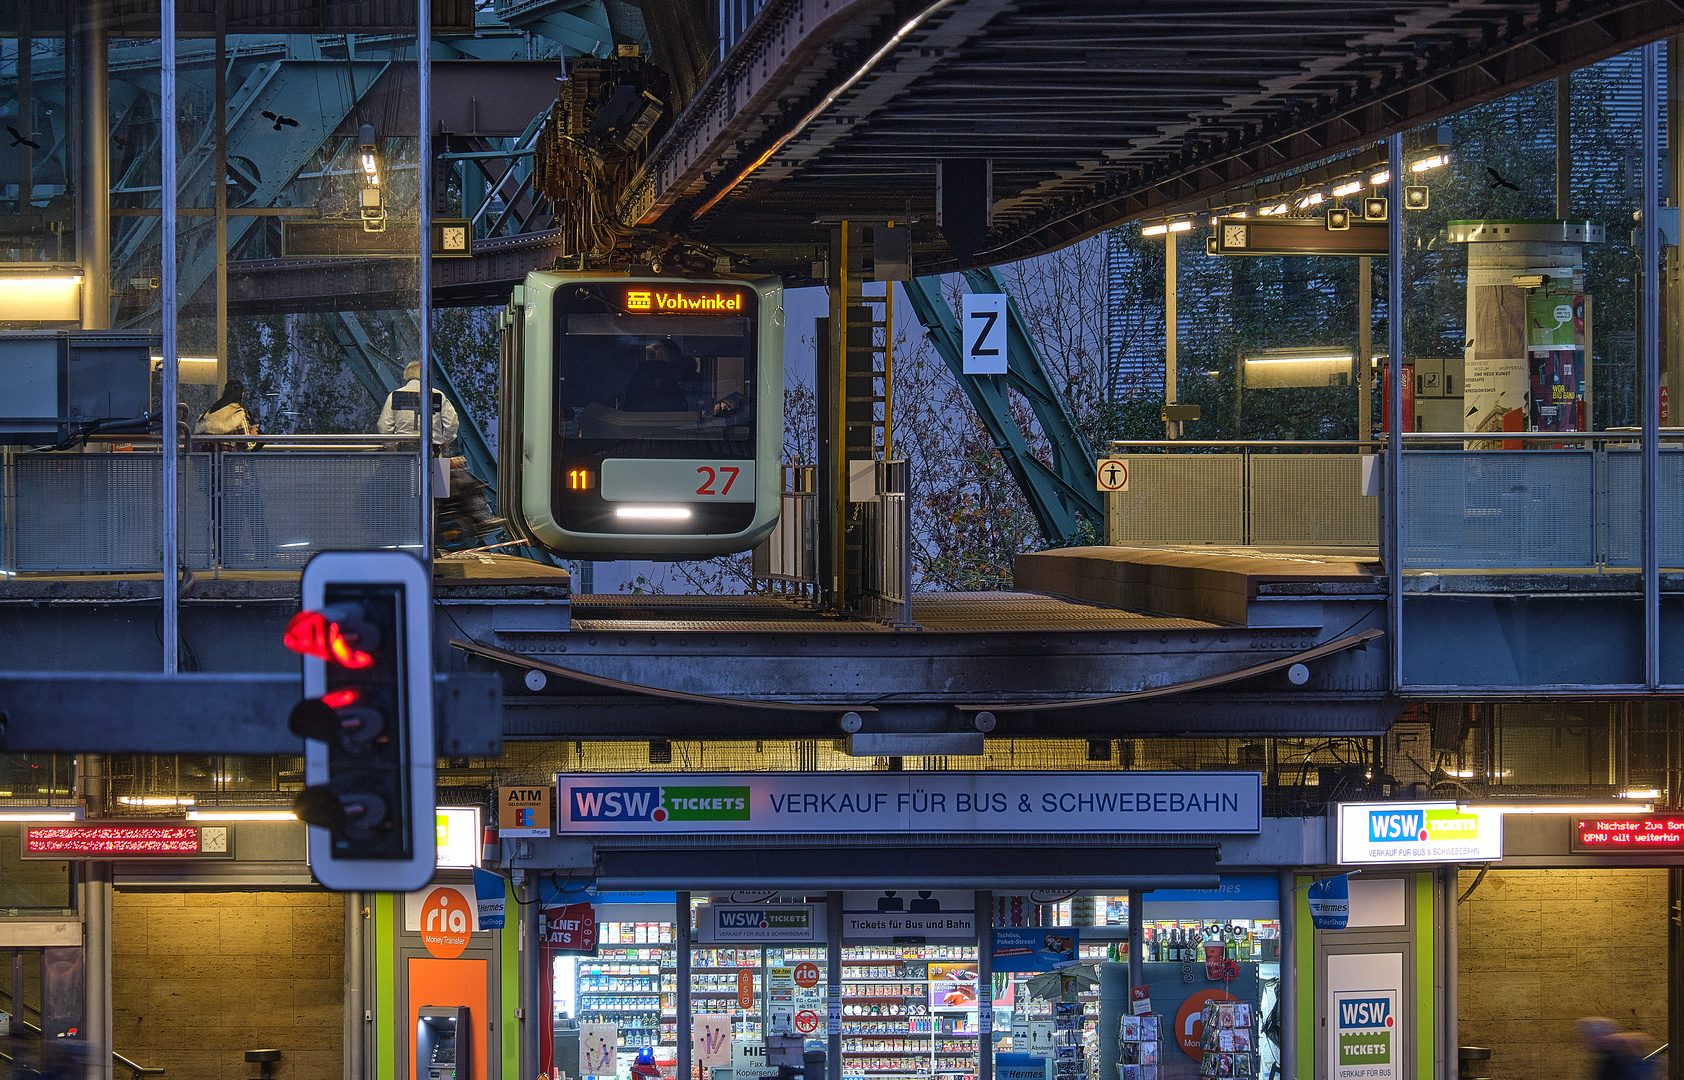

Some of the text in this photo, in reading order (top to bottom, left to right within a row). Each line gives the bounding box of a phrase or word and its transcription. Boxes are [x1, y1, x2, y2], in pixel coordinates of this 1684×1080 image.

[656, 293, 741, 310] Vohwinkel
[970, 312, 999, 356] Z
[569, 470, 588, 489] 11
[695, 466, 740, 496] 27
[508, 790, 542, 801] ATM
[769, 789, 1238, 813] VERKAUF FÜR BUS & SCHWEBEBAHN
[575, 792, 745, 817] WSW TICKETS
[1371, 814, 1476, 838] WSW TICKETS
[1596, 822, 1640, 830] Nächster
[1583, 833, 1608, 842] ÖPNV
[1634, 833, 1680, 842] weiterhin
[1368, 848, 1397, 857] VERKAUF
[1399, 847, 1411, 857] FÜR
[1412, 848, 1426, 857] BUS
[1433, 847, 1480, 856] SCHWEBEBAHN
[480, 903, 504, 912] Hermes
[1320, 903, 1347, 912] Hermes
[426, 896, 466, 933] ria
[722, 913, 807, 926] WSW TICKETS
[850, 920, 971, 929] Tickets für Bus und Bahn
[1318, 918, 1347, 926] PaketShop
[1203, 924, 1220, 937] TO
[1224, 923, 1242, 936] GO
[425, 935, 465, 945] Money Transfer
[1182, 934, 1204, 983] COFFEE
[796, 965, 817, 979] ria
[1342, 1002, 1386, 1025] WSW
[1184, 1039, 1200, 1047] Mon
[1344, 1043, 1386, 1056] TICKETS
[743, 1047, 767, 1056] HIE
[1009, 1070, 1044, 1078] Hermes
[1339, 1068, 1391, 1078] VERKAUF FÜR BUS
